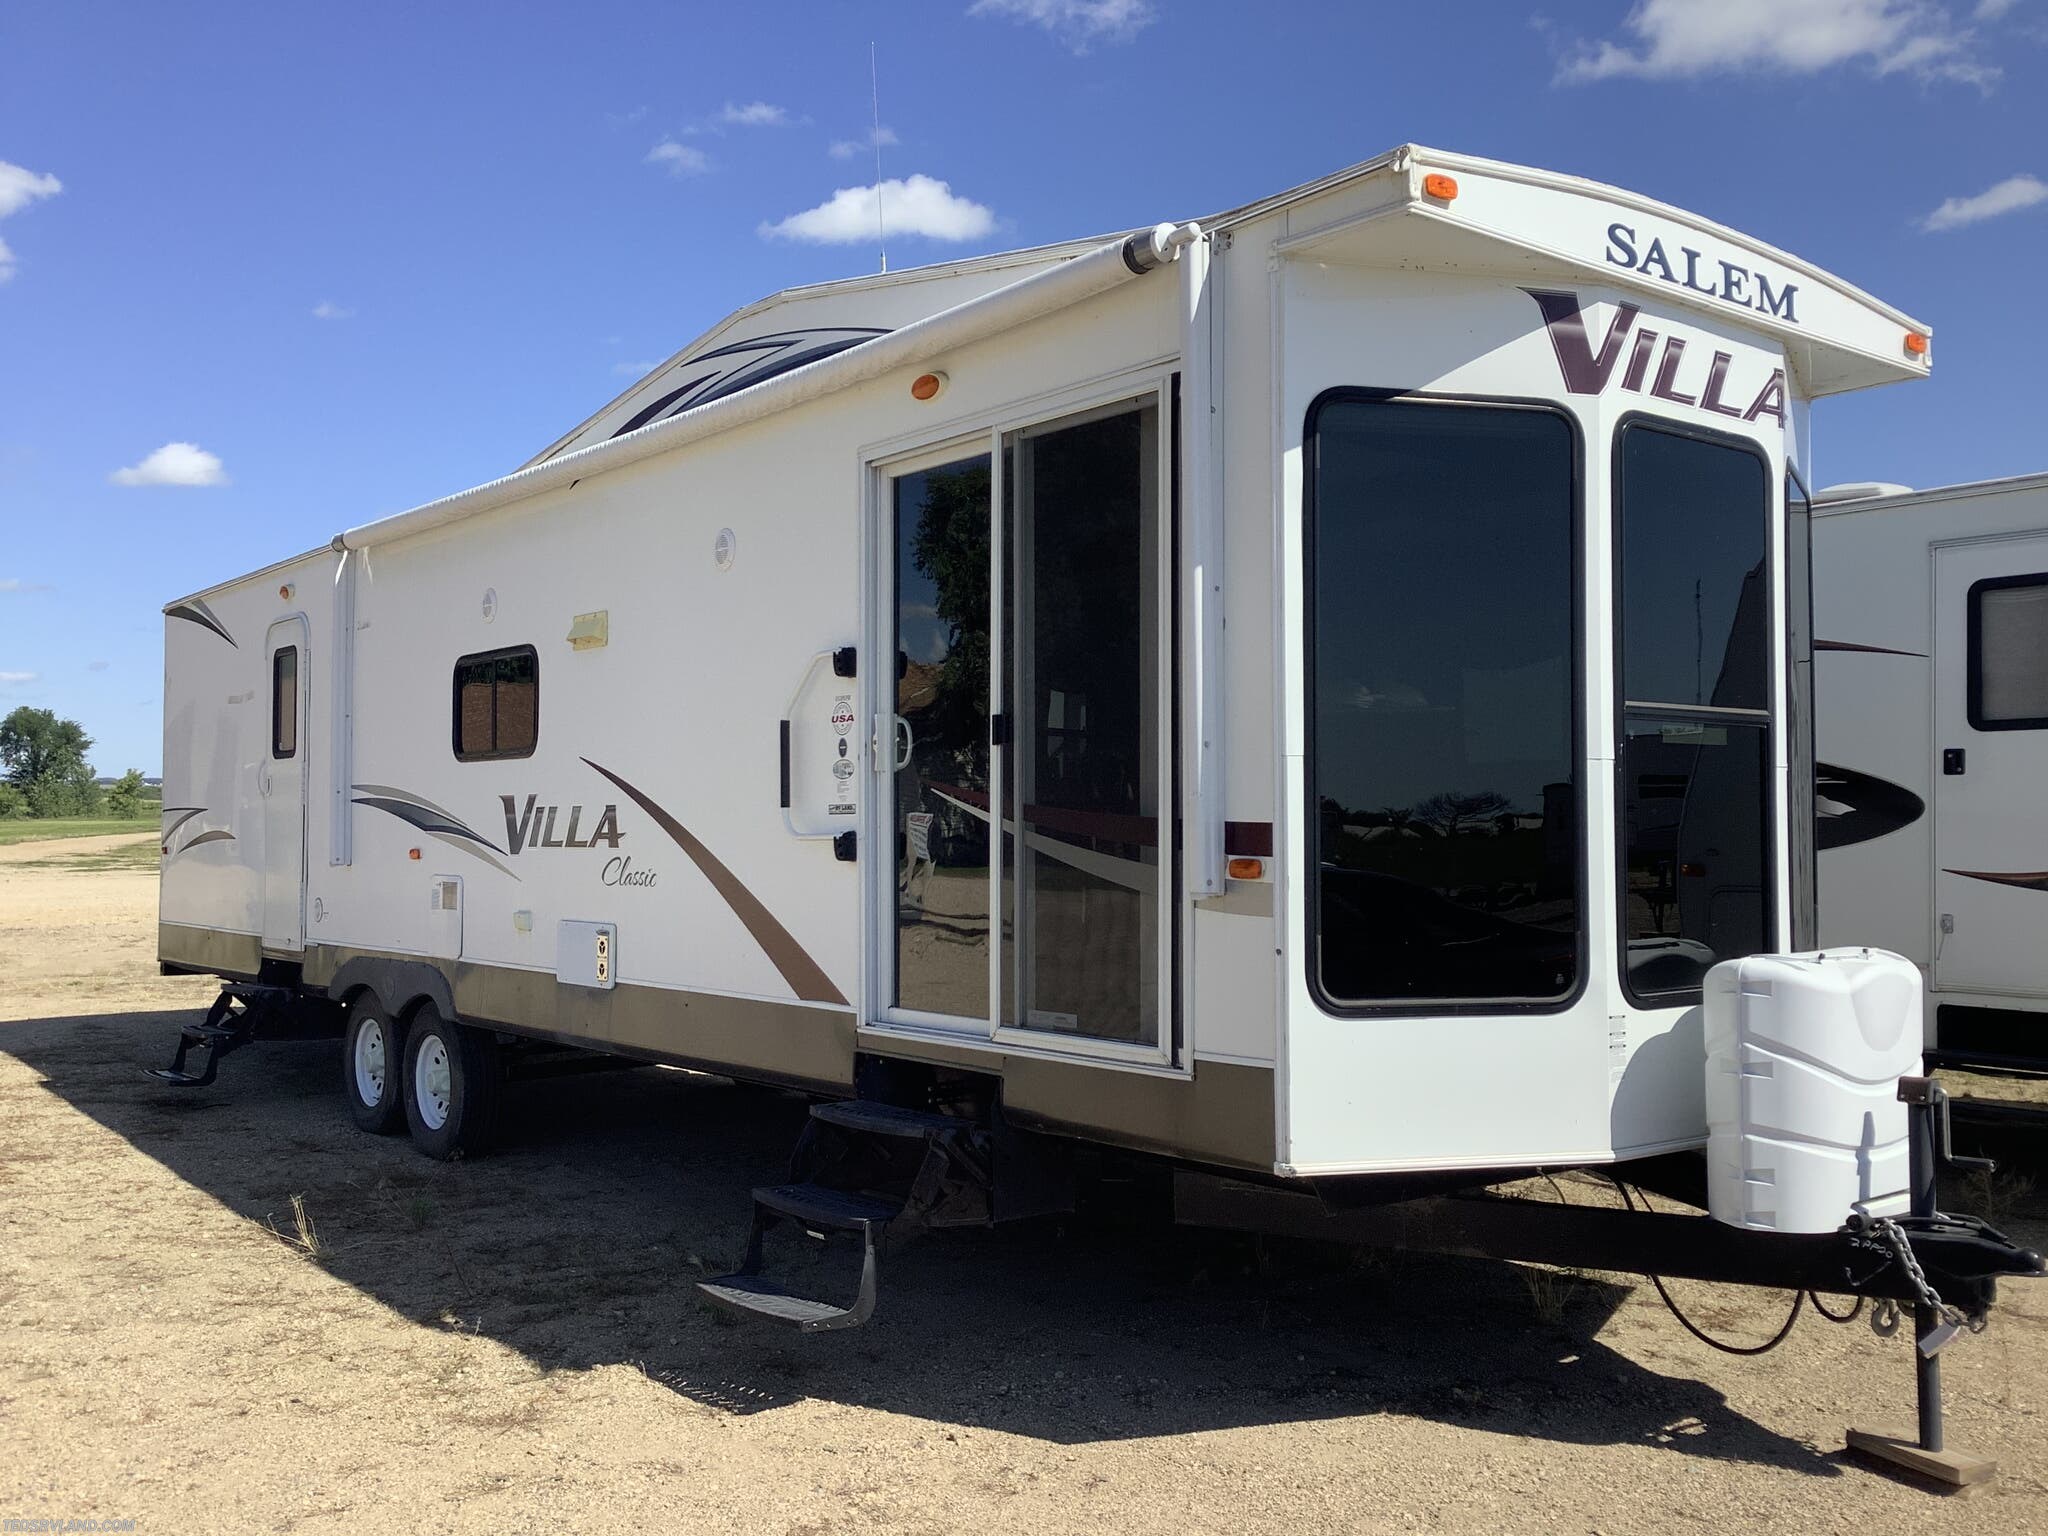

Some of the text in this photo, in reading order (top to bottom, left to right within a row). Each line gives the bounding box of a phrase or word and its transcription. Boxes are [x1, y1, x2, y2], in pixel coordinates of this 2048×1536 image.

[1606, 223, 1799, 323] SALEM
[1517, 285, 1785, 430] VILLA
[831, 714, 854, 723] USA
[499, 794, 626, 855] VILLA
[601, 855, 657, 887] Classic
